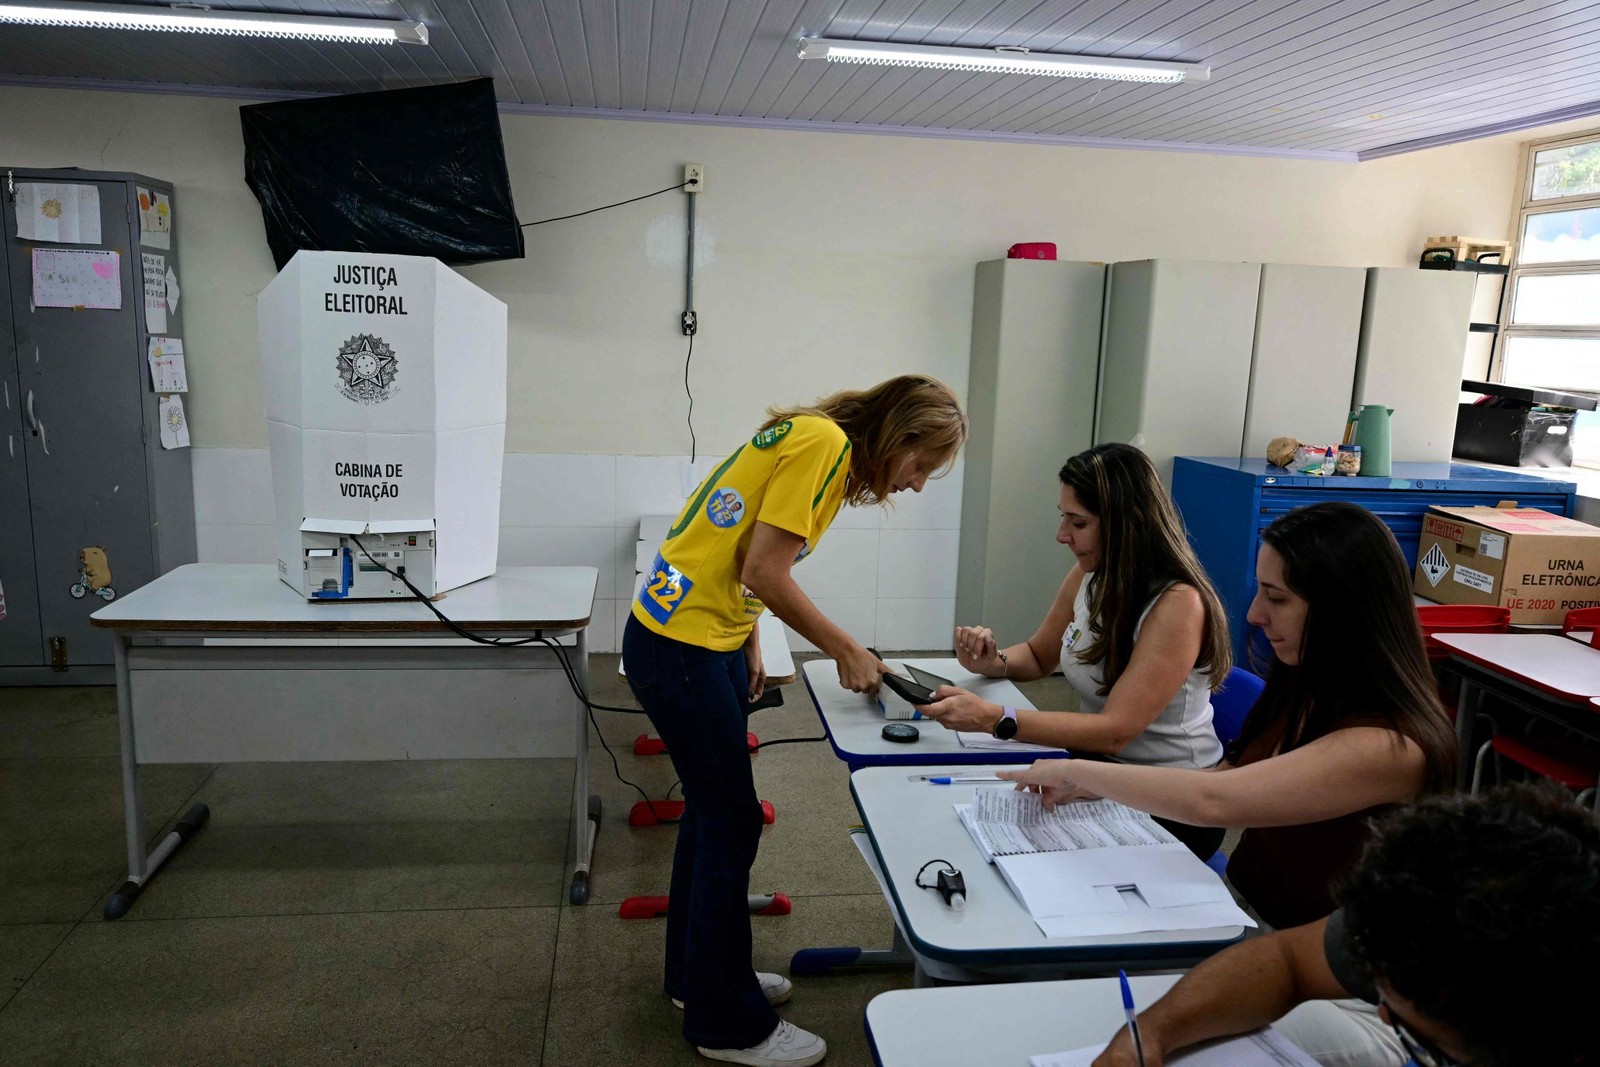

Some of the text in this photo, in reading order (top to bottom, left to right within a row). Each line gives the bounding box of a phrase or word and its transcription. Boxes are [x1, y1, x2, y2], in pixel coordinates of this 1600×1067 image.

[333, 264, 398, 291] JUSTIÇA
[325, 293, 408, 315] ELEITORAL
[335, 462, 403, 478] CABINA DE
[340, 482, 399, 502] VOTAÇÃO
[1548, 559, 1584, 571] URNA
[1521, 573, 1600, 587] ELETRÔNICA
[647, 570, 683, 612] 22
[1506, 599, 1524, 609] UE
[1527, 599, 1556, 610] 2020
